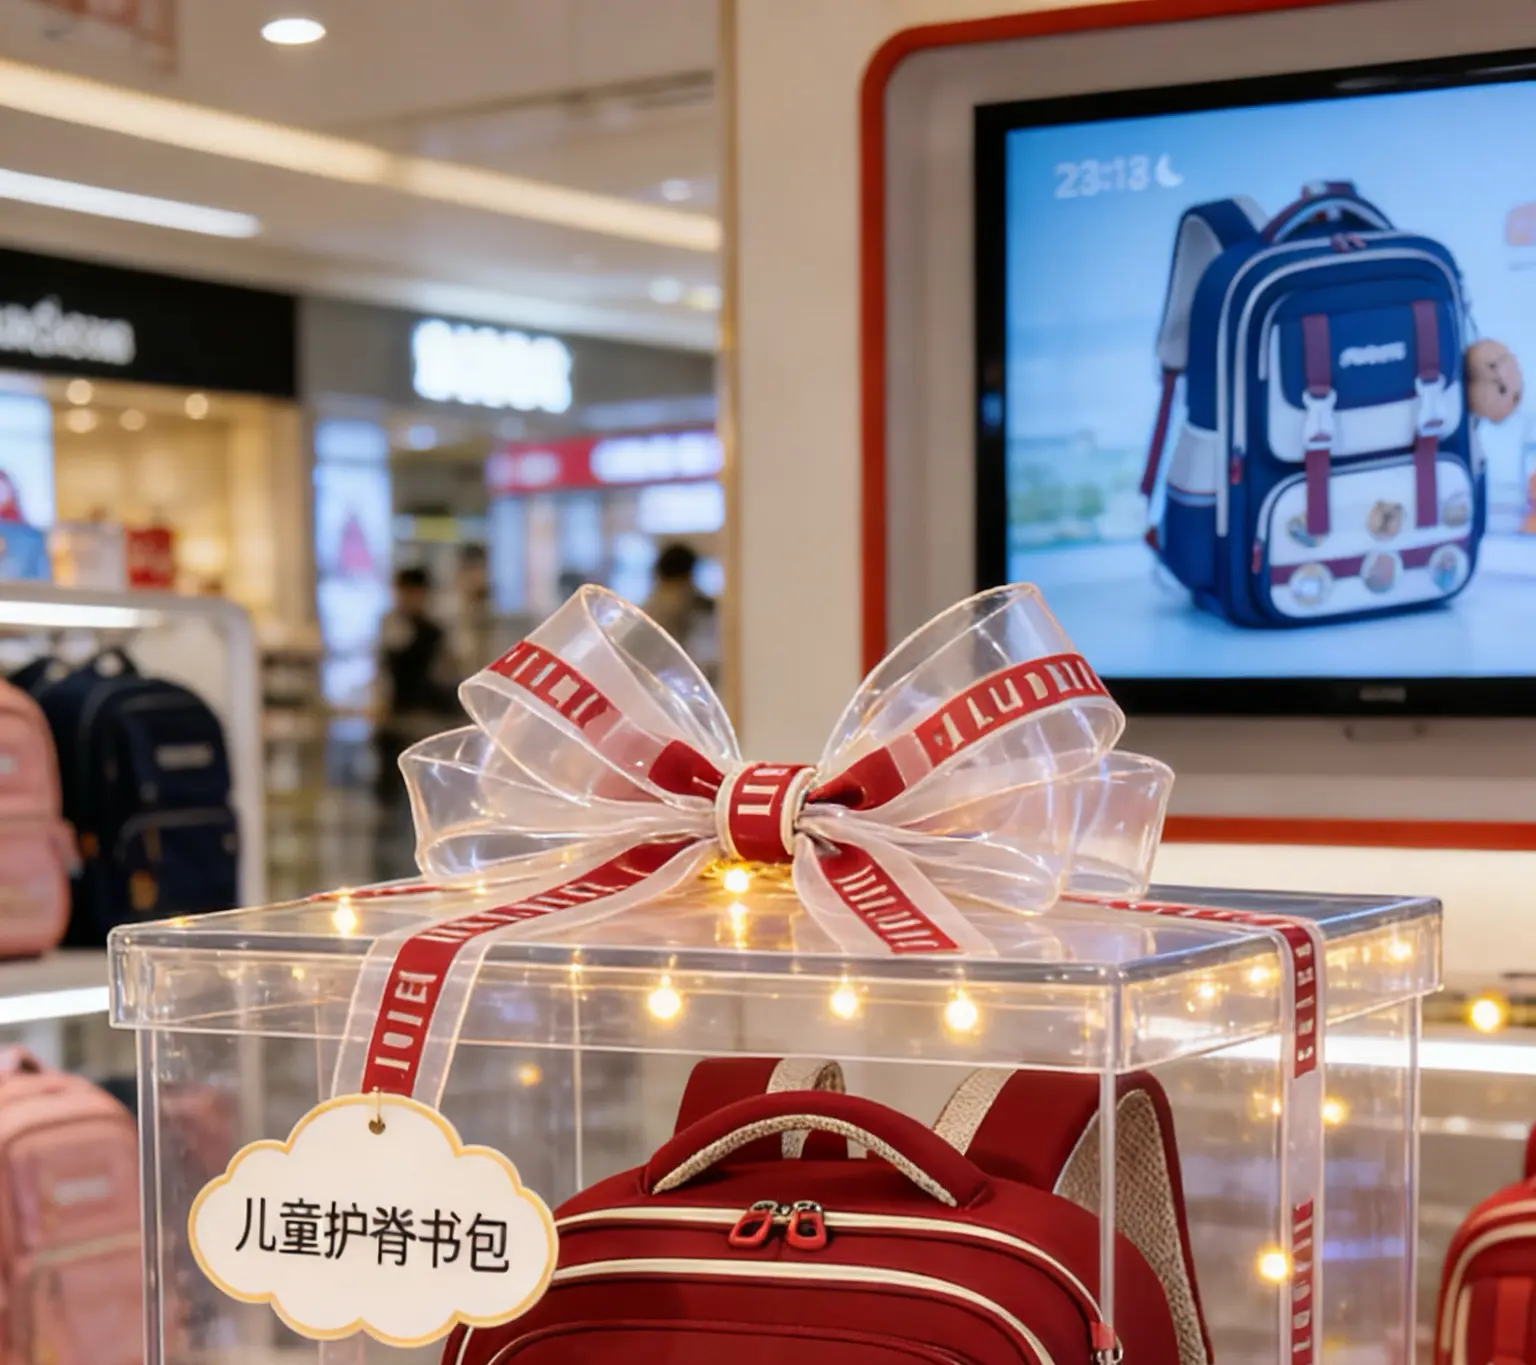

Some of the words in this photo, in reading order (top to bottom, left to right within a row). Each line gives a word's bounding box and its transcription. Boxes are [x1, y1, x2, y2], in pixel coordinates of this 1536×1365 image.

[235, 1197, 510, 1273] 儿童护脊书包
